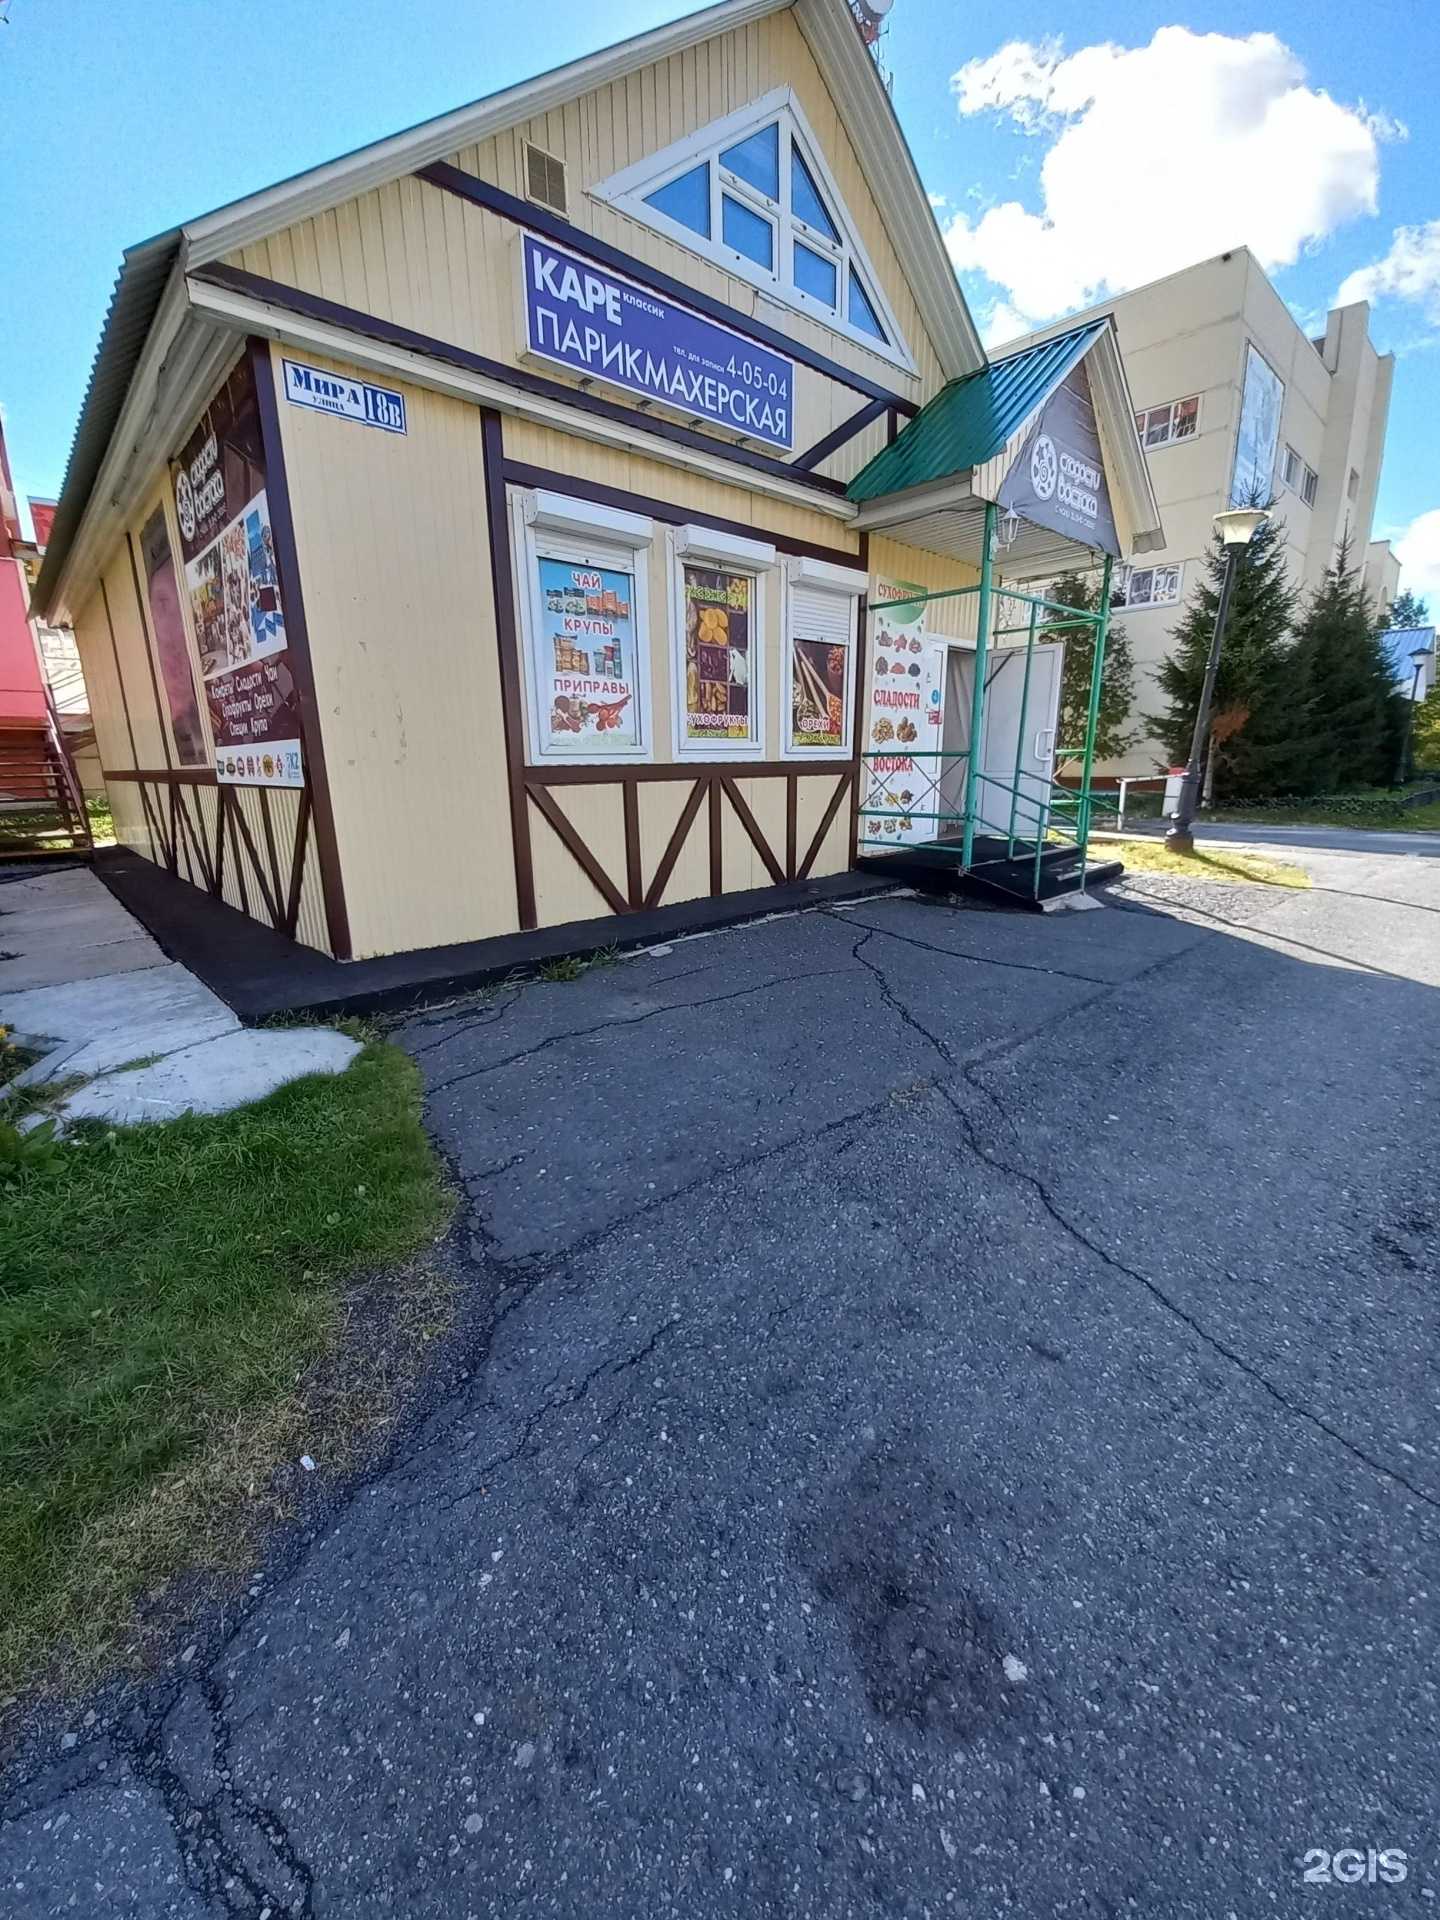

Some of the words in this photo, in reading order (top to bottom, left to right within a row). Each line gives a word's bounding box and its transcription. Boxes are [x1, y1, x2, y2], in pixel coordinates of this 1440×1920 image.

[533, 248, 623, 327] КАРЕ
[622, 291, 666, 320] классик
[536, 305, 787, 439] ПАРИКМАХЕРСКАЯ
[726, 354, 788, 401] 4-05-04
[572, 572, 601, 590] ЧАЙ
[564, 618, 613, 635] КРУПЫ
[553, 679, 630, 695] ПРИПРАВЫ
[873, 689, 921, 710] СЛАДОСТИ
[801, 718, 830, 731] ОРЕХИ
[873, 756, 913, 773] ВОСТОКА
